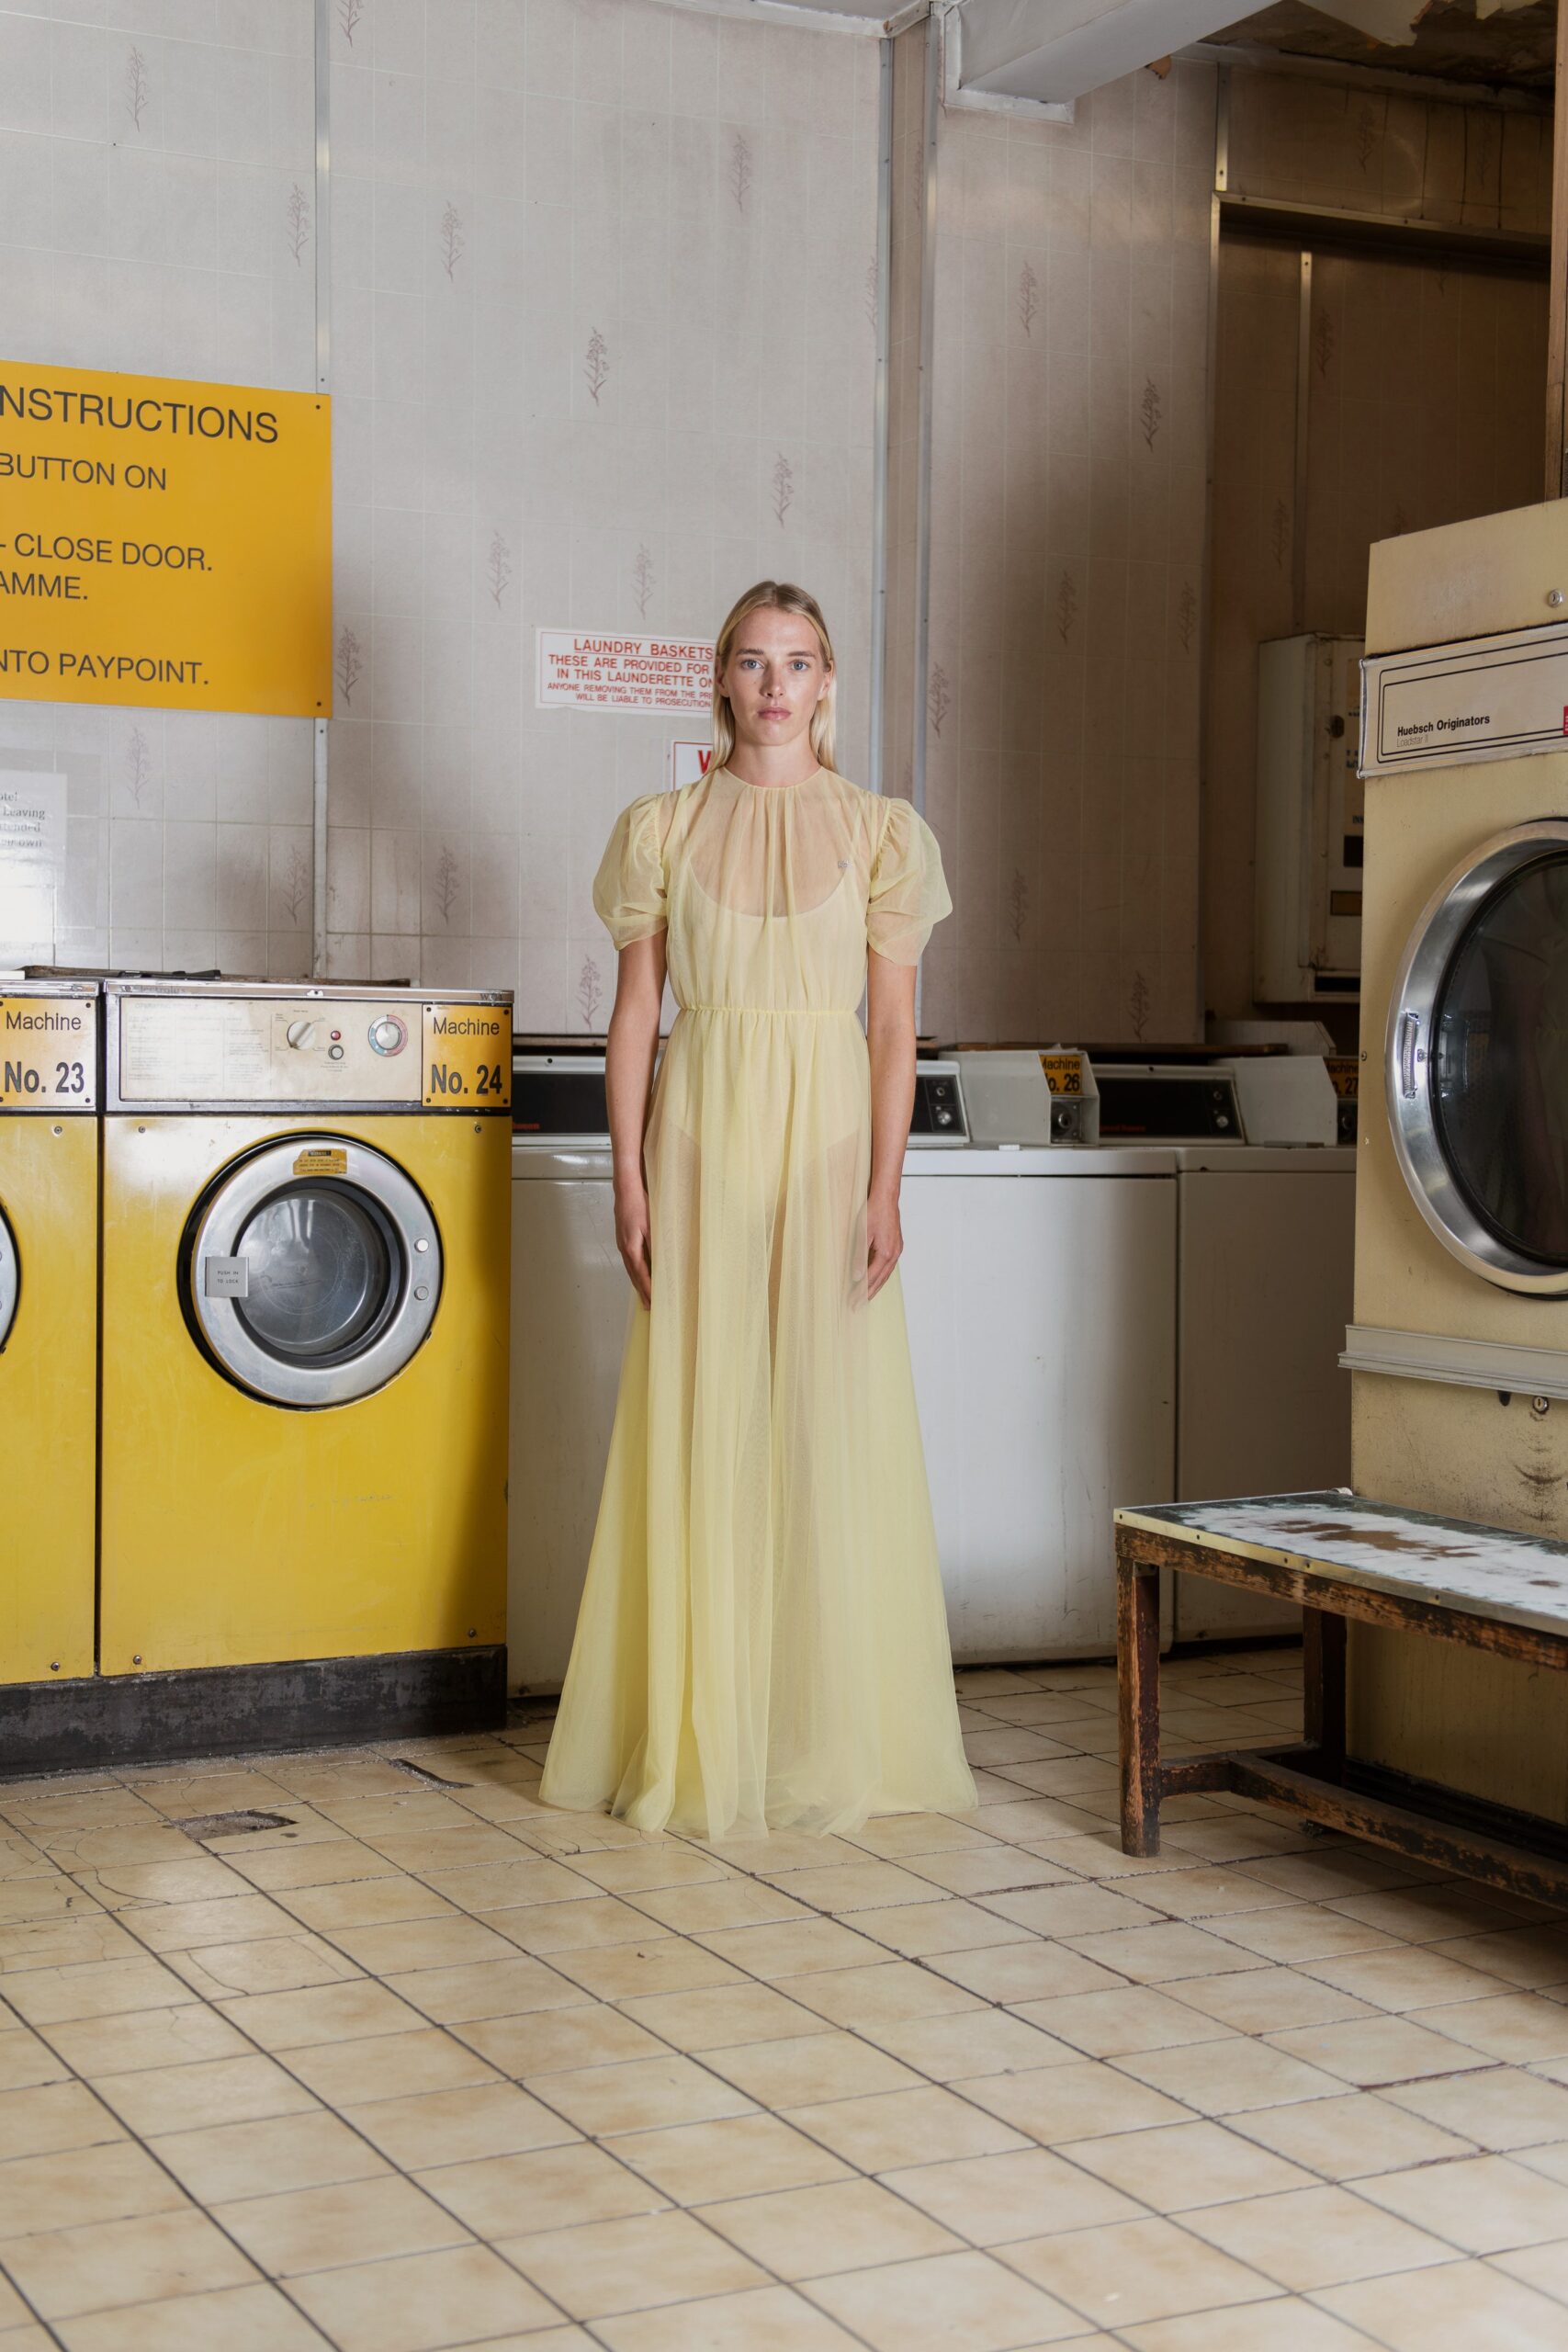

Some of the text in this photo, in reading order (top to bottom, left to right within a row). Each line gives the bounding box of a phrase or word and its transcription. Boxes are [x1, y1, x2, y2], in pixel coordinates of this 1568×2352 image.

[0, 385, 278, 444] NSTRUCTIONS
[0, 452, 167, 491] BUTTON ON
[14, 533, 112, 563] CLOSE
[122, 542, 212, 571] DOOR.
[573, 639, 713, 660] LAUNDRY BASKETS
[60, 653, 209, 684] PAYPOINT.
[548, 654, 709, 674] THESE ARE PROVIDED FOR
[557, 668, 569, 679] IN
[574, 669, 602, 681] THIS
[608, 672, 694, 687] LAUNDERETTE
[547, 683, 580, 691] ANYONE
[583, 684, 626, 694] REMOVING
[630, 686, 652, 695] THEM
[655, 688, 677, 696] FROM
[681, 690, 695, 698] THE
[597, 694, 607, 702] BE
[612, 695, 638, 704] LIABLE
[641, 696, 652, 705] TO
[1397, 715, 1490, 737] Huebsch Originators
[3, 807, 45, 820] Leaving
[6, 1011, 82, 1031] Machine
[433, 1017, 501, 1035] Machine
[5, 1060, 85, 1093] No. 23
[431, 1064, 503, 1094] No. 24
[1046, 1073, 1080, 1091] o. 26
[1345, 1077, 1359, 1095] 27
